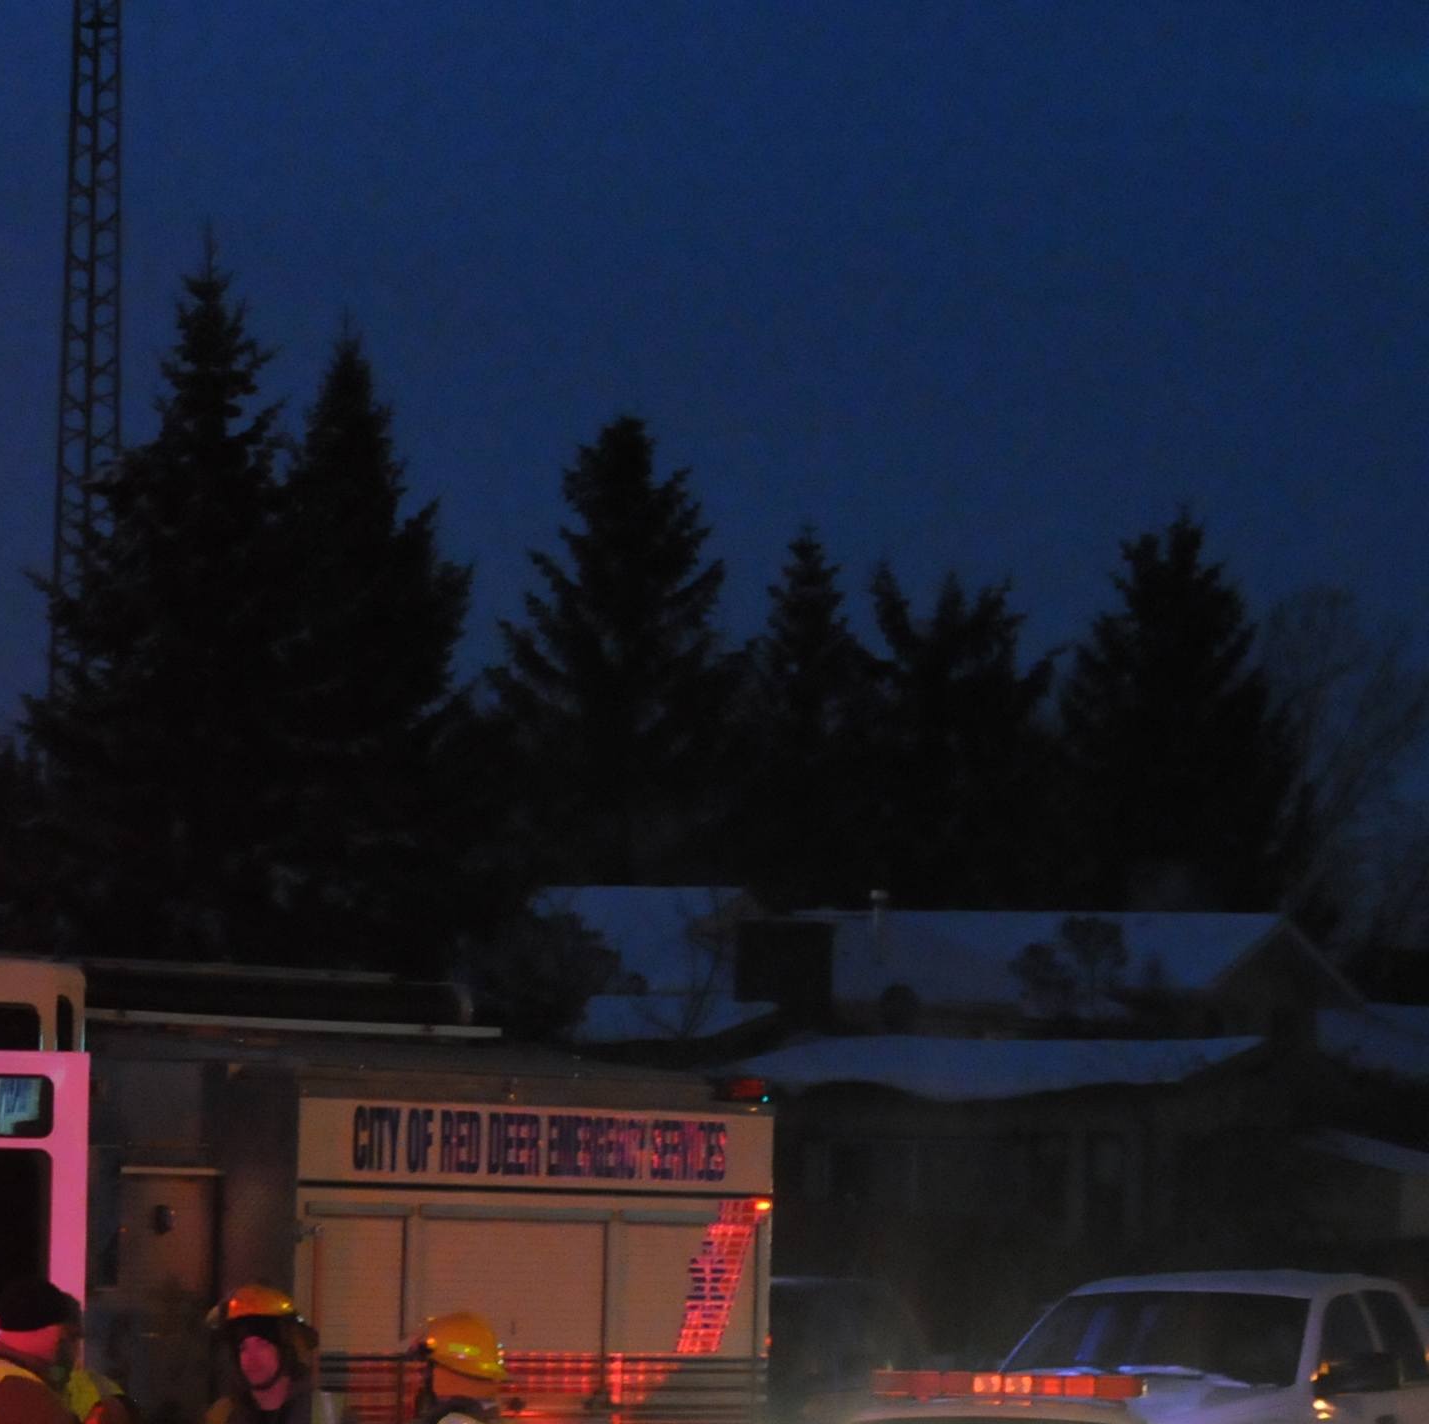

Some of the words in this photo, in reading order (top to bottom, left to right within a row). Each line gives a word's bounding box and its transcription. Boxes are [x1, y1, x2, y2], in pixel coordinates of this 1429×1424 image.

[353, 1105, 401, 1172] CITY
[407, 1107, 434, 1173] OF
[439, 1108, 481, 1174] RED
[487, 1111, 540, 1177] DEER
